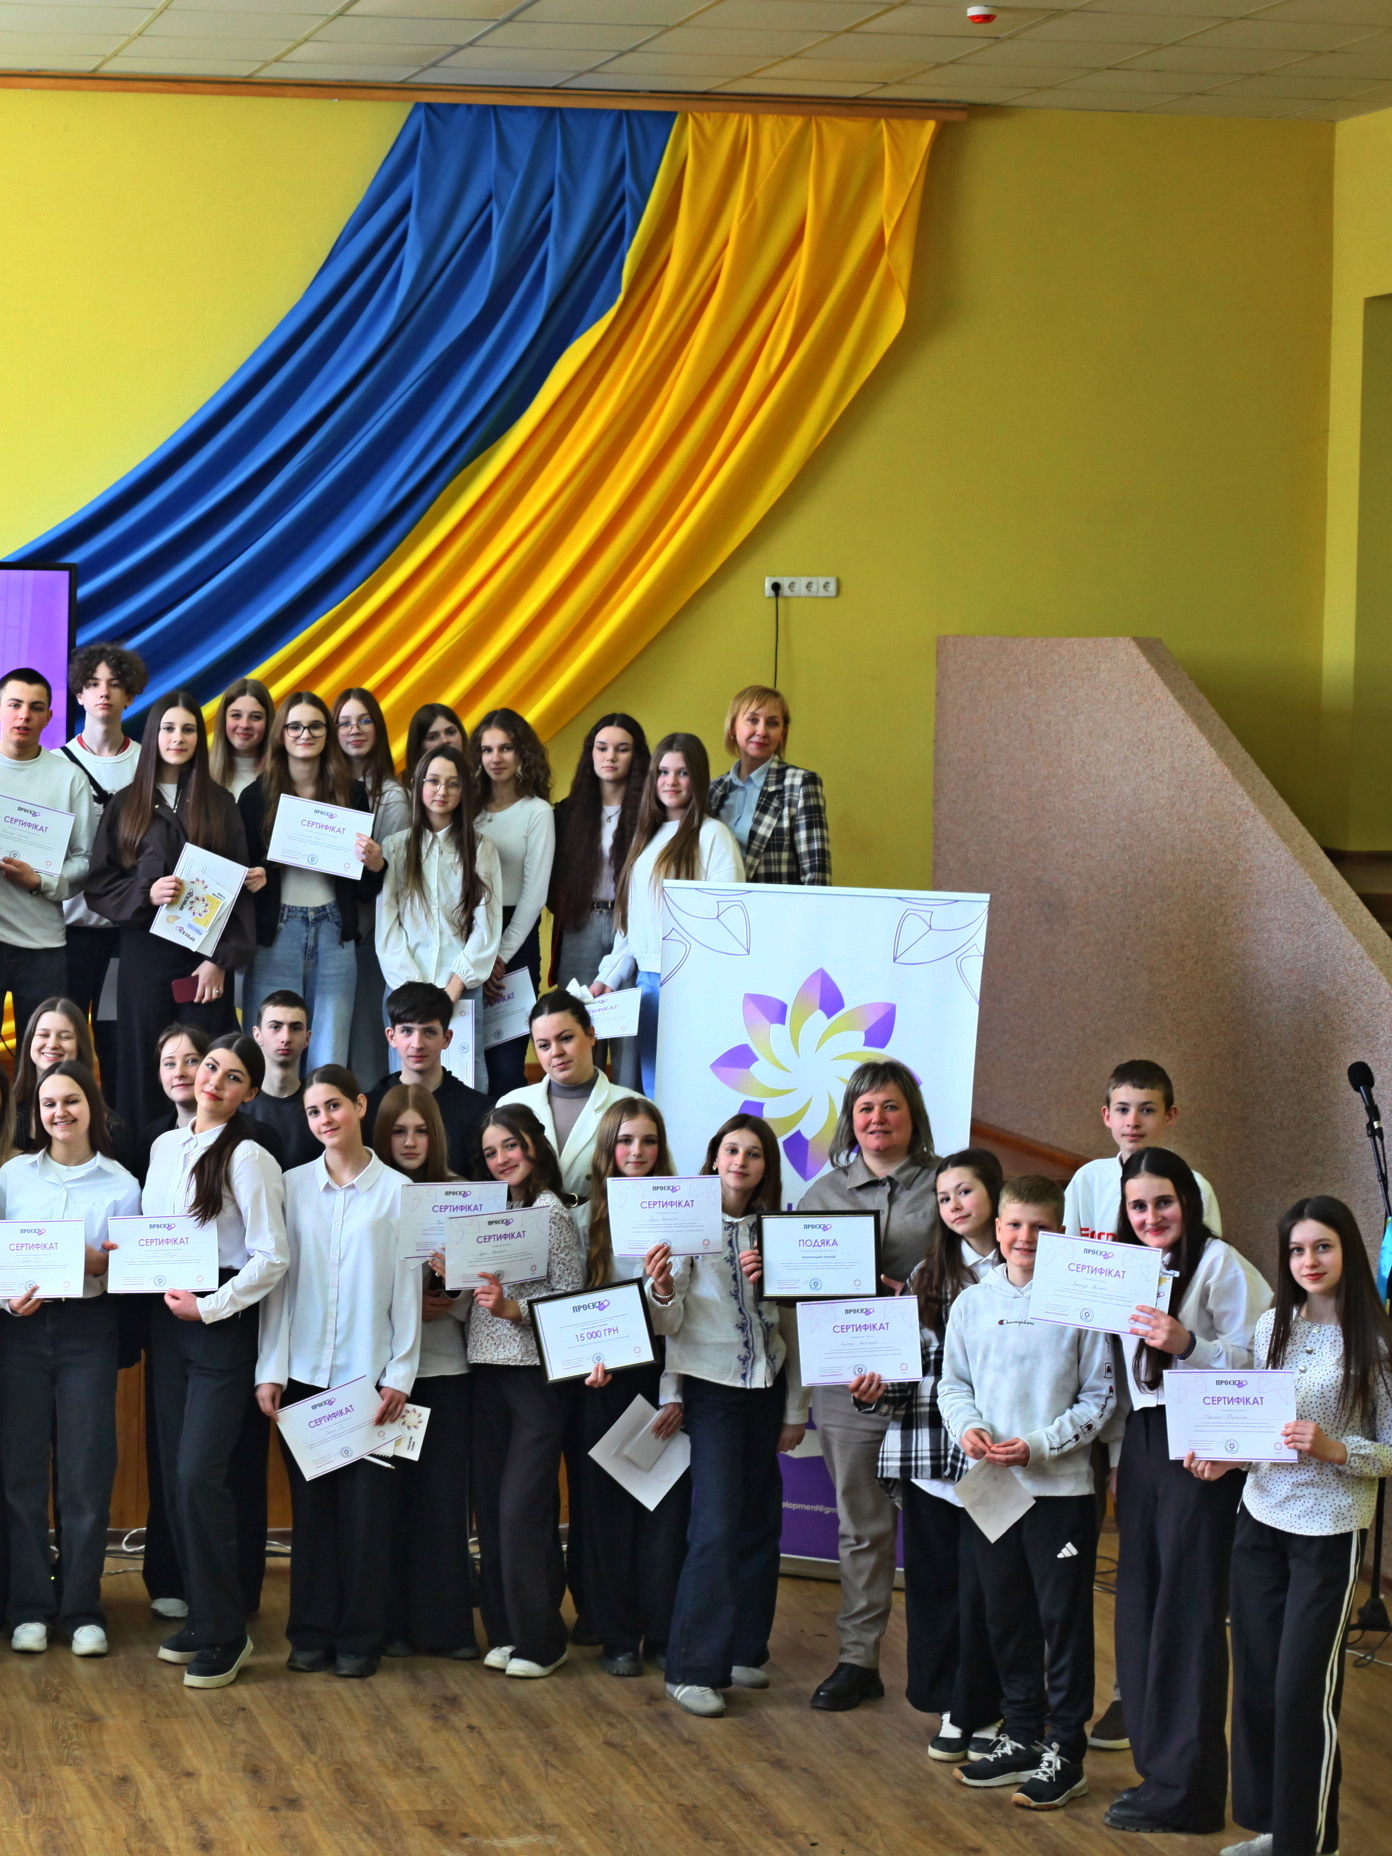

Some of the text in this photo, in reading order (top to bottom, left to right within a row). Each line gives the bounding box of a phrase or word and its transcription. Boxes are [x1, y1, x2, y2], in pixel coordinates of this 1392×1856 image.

[4, 815, 49, 833] СЕРТИФІКАТ
[300, 819, 346, 835] СЕРТИФІКАТ
[431, 1203, 483, 1213] СЕРТИФІКАТ
[640, 1199, 695, 1209] СЕРТИФІКАТ
[138, 1237, 190, 1247] СЕРТИФІКАТ
[476, 1230, 526, 1244] СЕРТИФІКАТ
[798, 1238, 839, 1248] ПОДЯКА
[8, 1242, 58, 1251] СЕРТИФІКАТ
[1067, 1262, 1127, 1280] СЕРТИФІКАТ
[575, 1326, 620, 1342] 15 000 ГРН
[832, 1322, 890, 1334] СЕРТИФІКАТ
[1202, 1396, 1264, 1406] СЕРТИФІКАТ
[308, 1404, 355, 1429] СЕРТИФІКАТ
